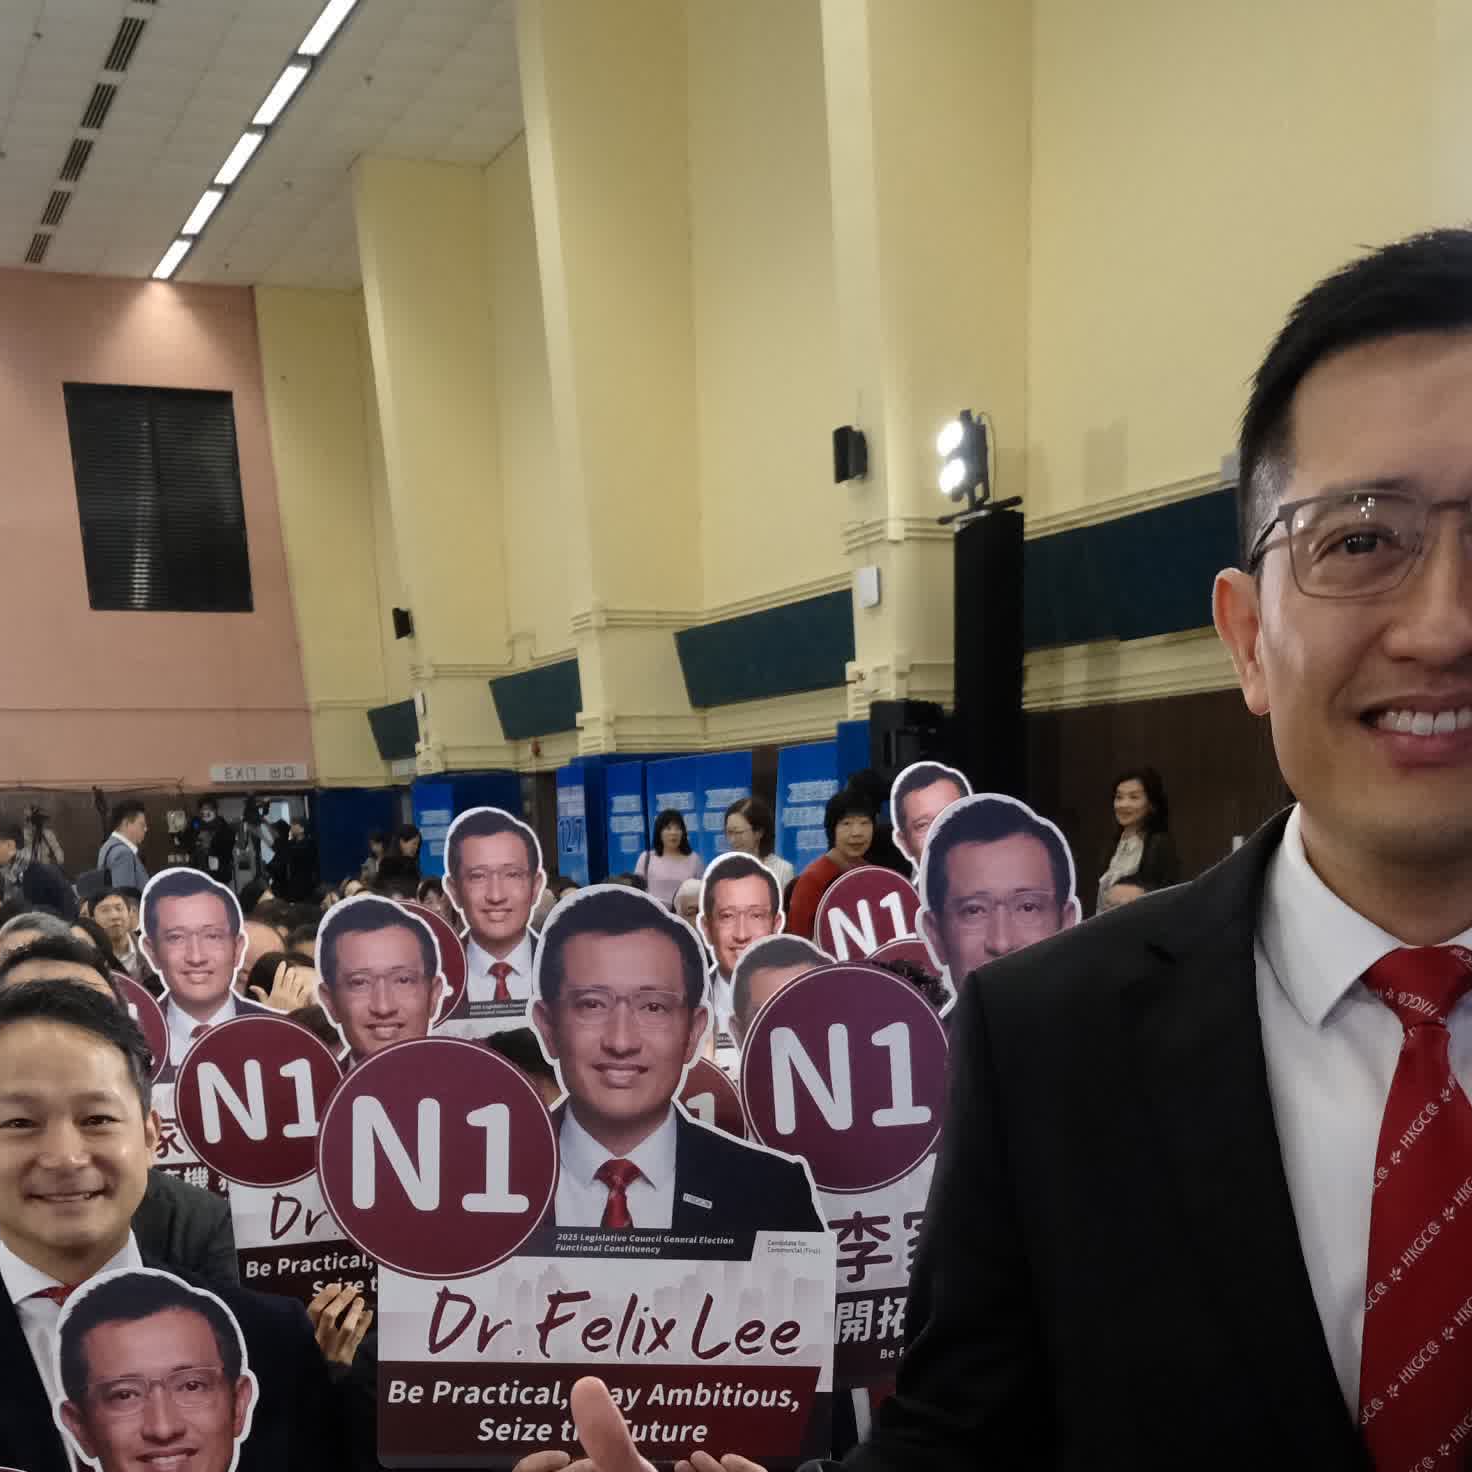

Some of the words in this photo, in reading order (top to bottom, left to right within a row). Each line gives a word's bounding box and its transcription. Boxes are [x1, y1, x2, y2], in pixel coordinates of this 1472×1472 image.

[828, 891, 918, 961] N1
[196, 1057, 321, 1144] N1
[768, 1022, 933, 1135] N1
[351, 1095, 530, 1214] N1
[246, 1260, 271, 1278] Be
[277, 1252, 374, 1275] Practical,
[428, 1286, 523, 1356] Dr.
[535, 1290, 674, 1360] Felix
[690, 1293, 801, 1360] Lee
[387, 1379, 424, 1403] Be
[432, 1380, 569, 1410] Practical,
[610, 1386, 642, 1412] ay
[646, 1382, 801, 1413] Ambitious,
[477, 1417, 553, 1442] Seize
